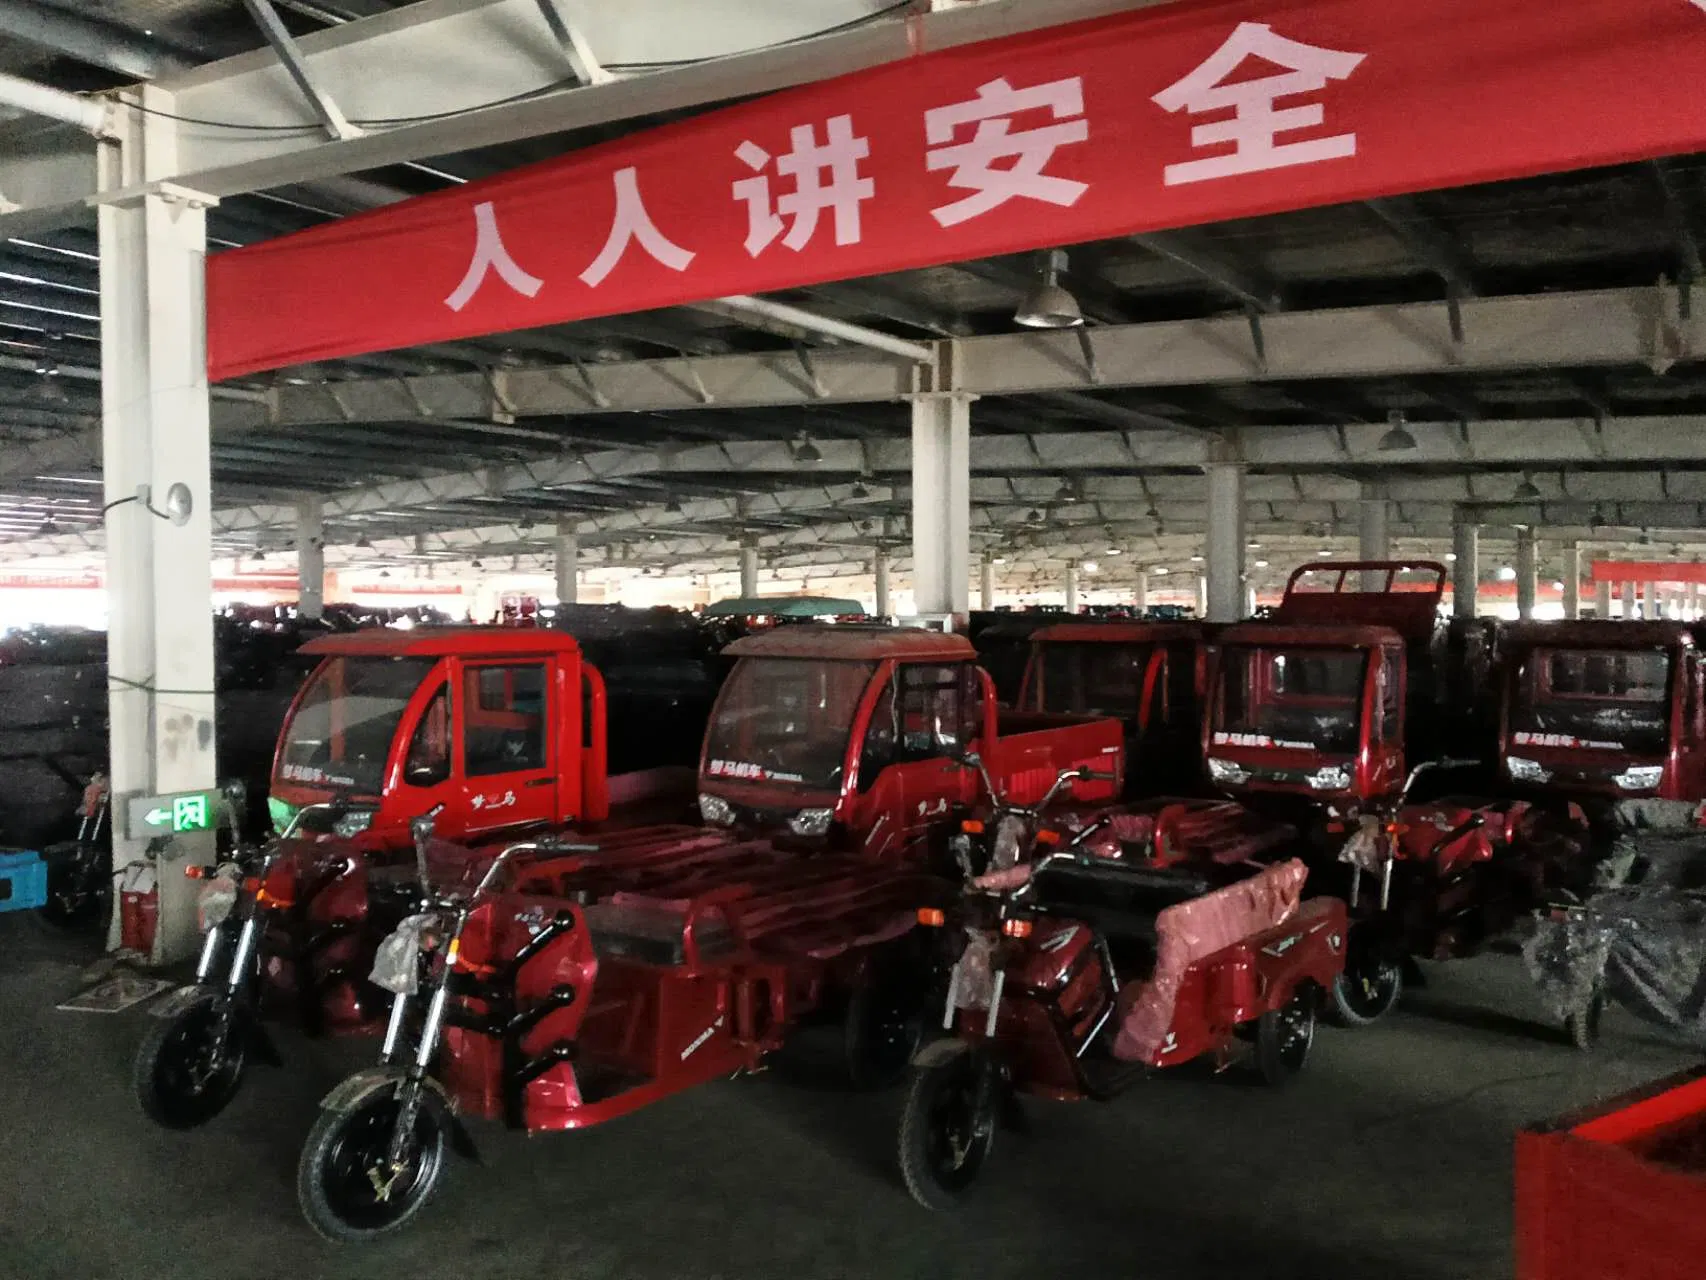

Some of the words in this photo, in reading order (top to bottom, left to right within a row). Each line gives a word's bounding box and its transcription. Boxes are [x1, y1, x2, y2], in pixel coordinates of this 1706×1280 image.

[444, 21, 1367, 311] 人人讲安全
